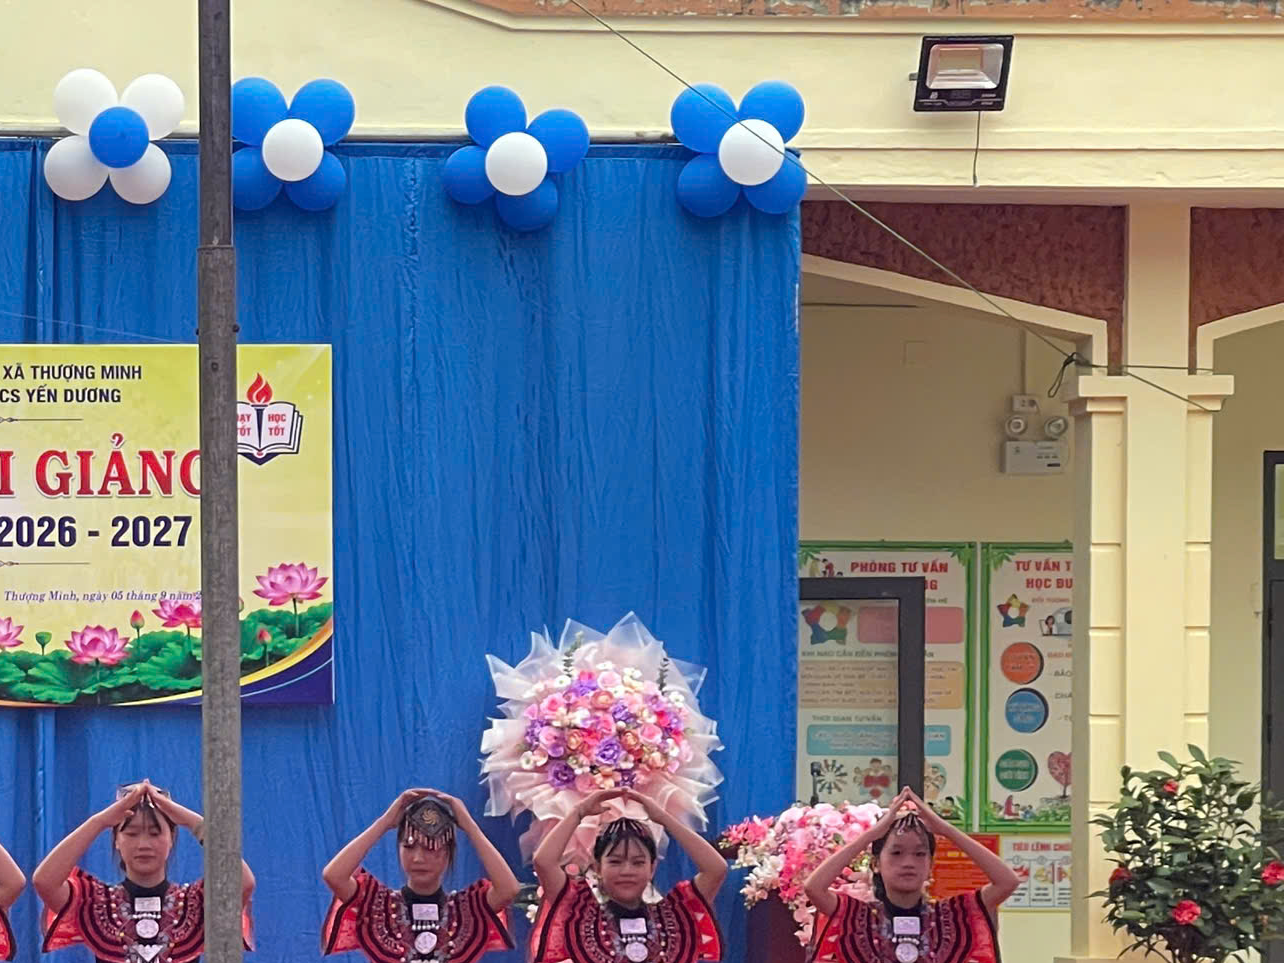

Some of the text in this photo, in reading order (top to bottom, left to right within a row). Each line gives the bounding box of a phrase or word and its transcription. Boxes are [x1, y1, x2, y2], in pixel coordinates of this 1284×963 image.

[2, 362, 25, 380] XÃ
[30, 364, 95, 383] THƯỢNG
[101, 365, 142, 380] MINH
[63, 387, 122, 403] DƯƠNG
[236, 413, 252, 424] ẠY
[88, 529, 99, 537] -
[111, 515, 193, 547] 2027
[4, 590, 46, 604] Thượng
[48, 590, 79, 602] Minh,
[82, 590, 107, 604] ngày
[111, 590, 124, 600] 05
[126, 590, 157, 604] tháng
[160, 590, 167, 600] 9
